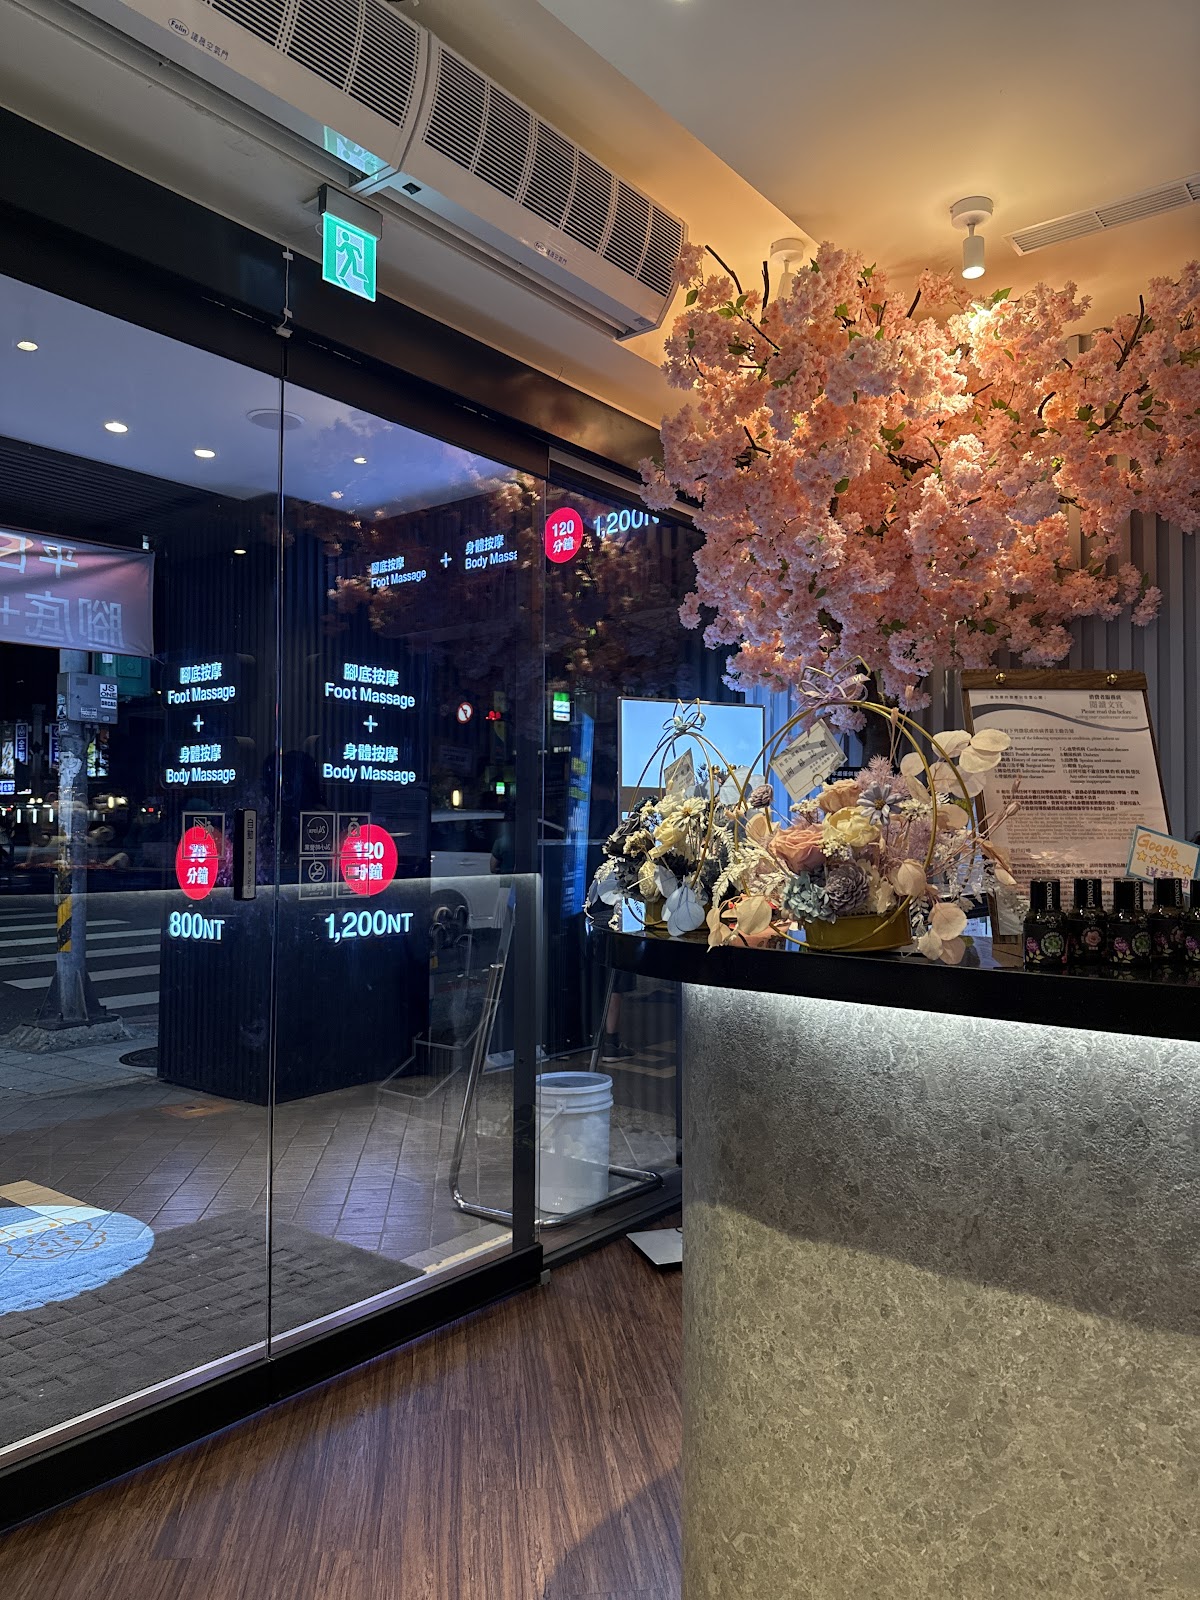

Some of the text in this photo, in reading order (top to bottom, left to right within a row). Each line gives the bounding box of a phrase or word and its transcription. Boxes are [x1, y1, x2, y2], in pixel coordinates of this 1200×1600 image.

[170, 20, 187, 34] Folin
[552, 519, 574, 537] 120
[465, 534, 504, 555] 身體按摩
[553, 536, 574, 554] 分鐘
[371, 556, 405, 576] 腳底按摩
[465, 555, 488, 570] Body
[371, 568, 427, 589] Foot Massage
[180, 662, 222, 684] 腳底按摩
[343, 663, 399, 687] 腳底按摩
[168, 684, 235, 705] Foot Massage
[325, 682, 415, 710] Foot Massage
[179, 744, 222, 764] 身體按摩
[343, 743, 398, 763] 身體按摩
[166, 767, 236, 786] Body Massage
[322, 763, 416, 785] Body Massage
[354, 842, 384, 860] 120
[1137, 833, 1178, 859] Google
[187, 866, 209, 885] 分鐘
[1086, 879, 1094, 908] COSMIC
[169, 911, 225, 941] 800NT
[325, 910, 414, 944] 1,200NT
